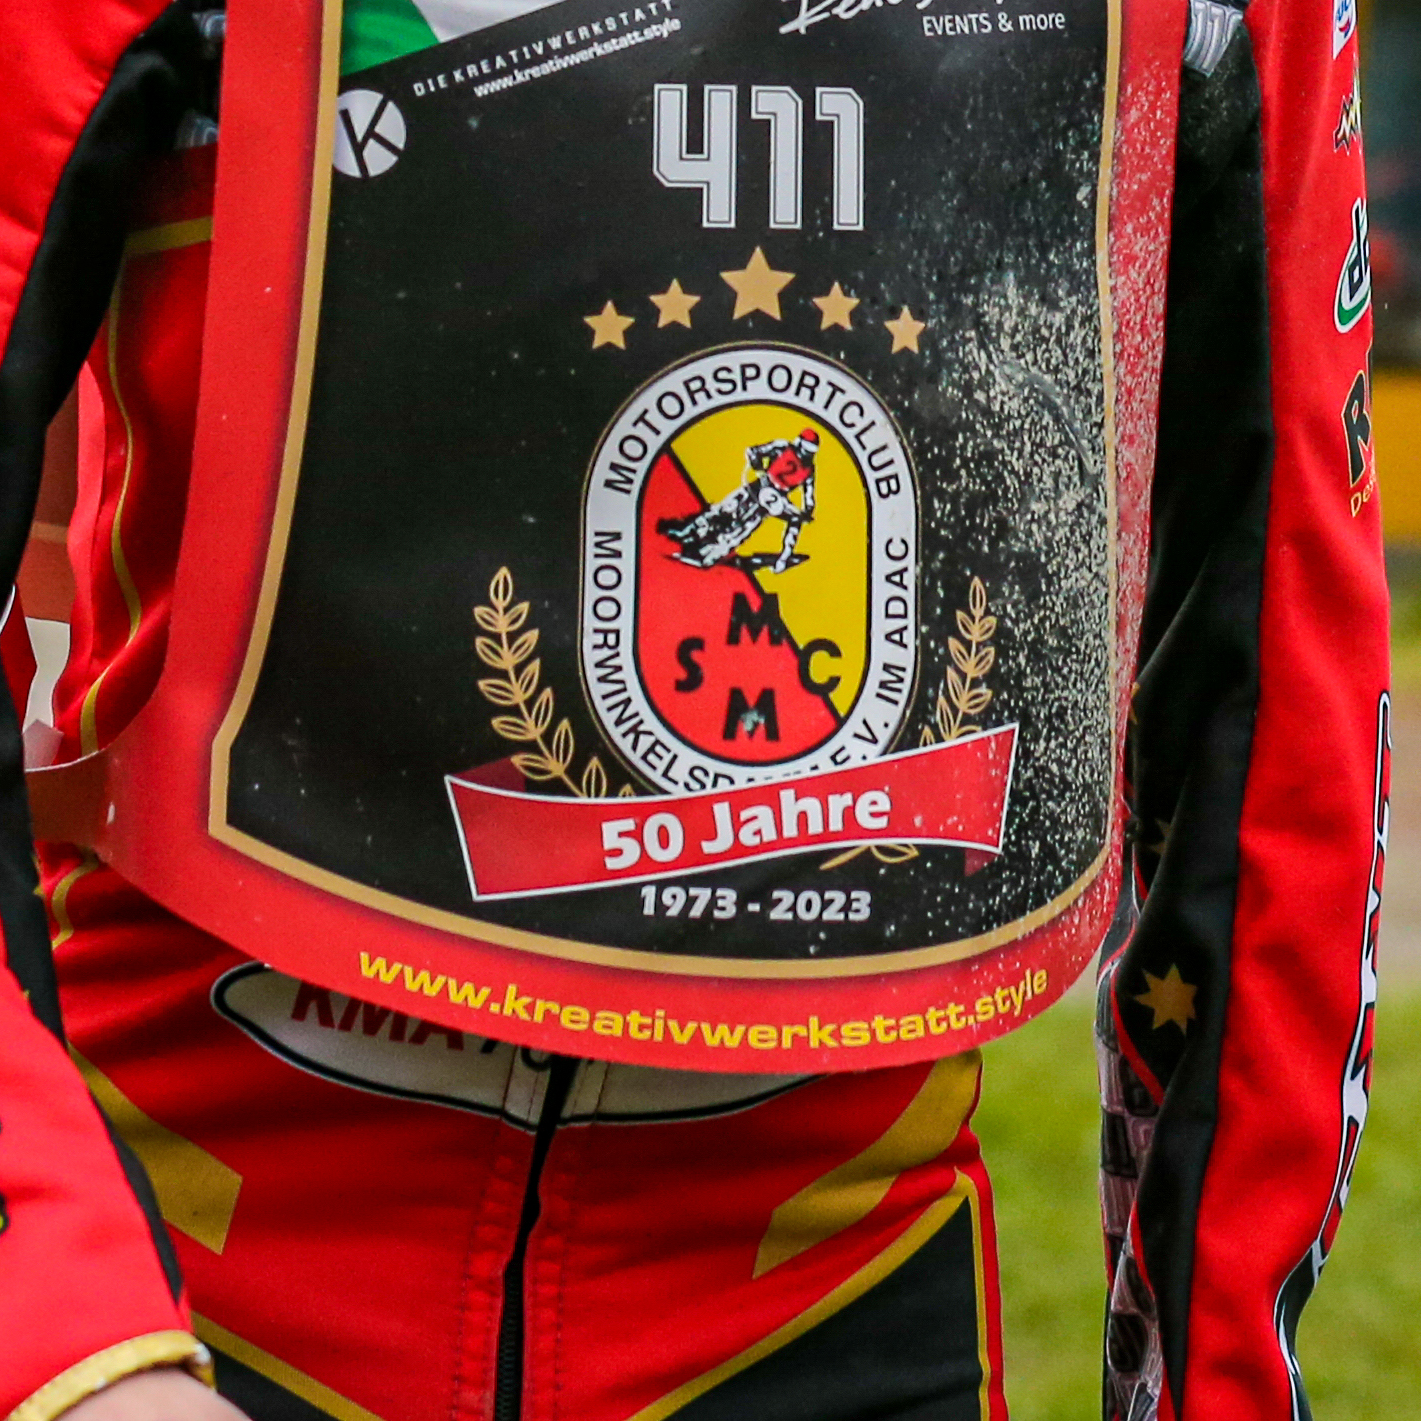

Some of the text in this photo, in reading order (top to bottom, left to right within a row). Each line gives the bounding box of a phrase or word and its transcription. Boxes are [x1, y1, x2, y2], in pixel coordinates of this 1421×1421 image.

[474, 17, 681, 98] www.kreativwerkstatt.style
[922, 11, 1066, 37] EVENTS & more
[413, 74, 449, 98] DIE
[652, 84, 865, 230] 411
[603, 362, 902, 499] MOTORSPORTCLUB
[885, 536, 910, 649] ADAC
[876, 664, 907, 706] IM
[601, 787, 892, 871] 50 Jahre
[639, 884, 738, 920] 1973
[769, 888, 872, 922] 2023
[358, 950, 1049, 1051] www.kreativwerkstatt.style
